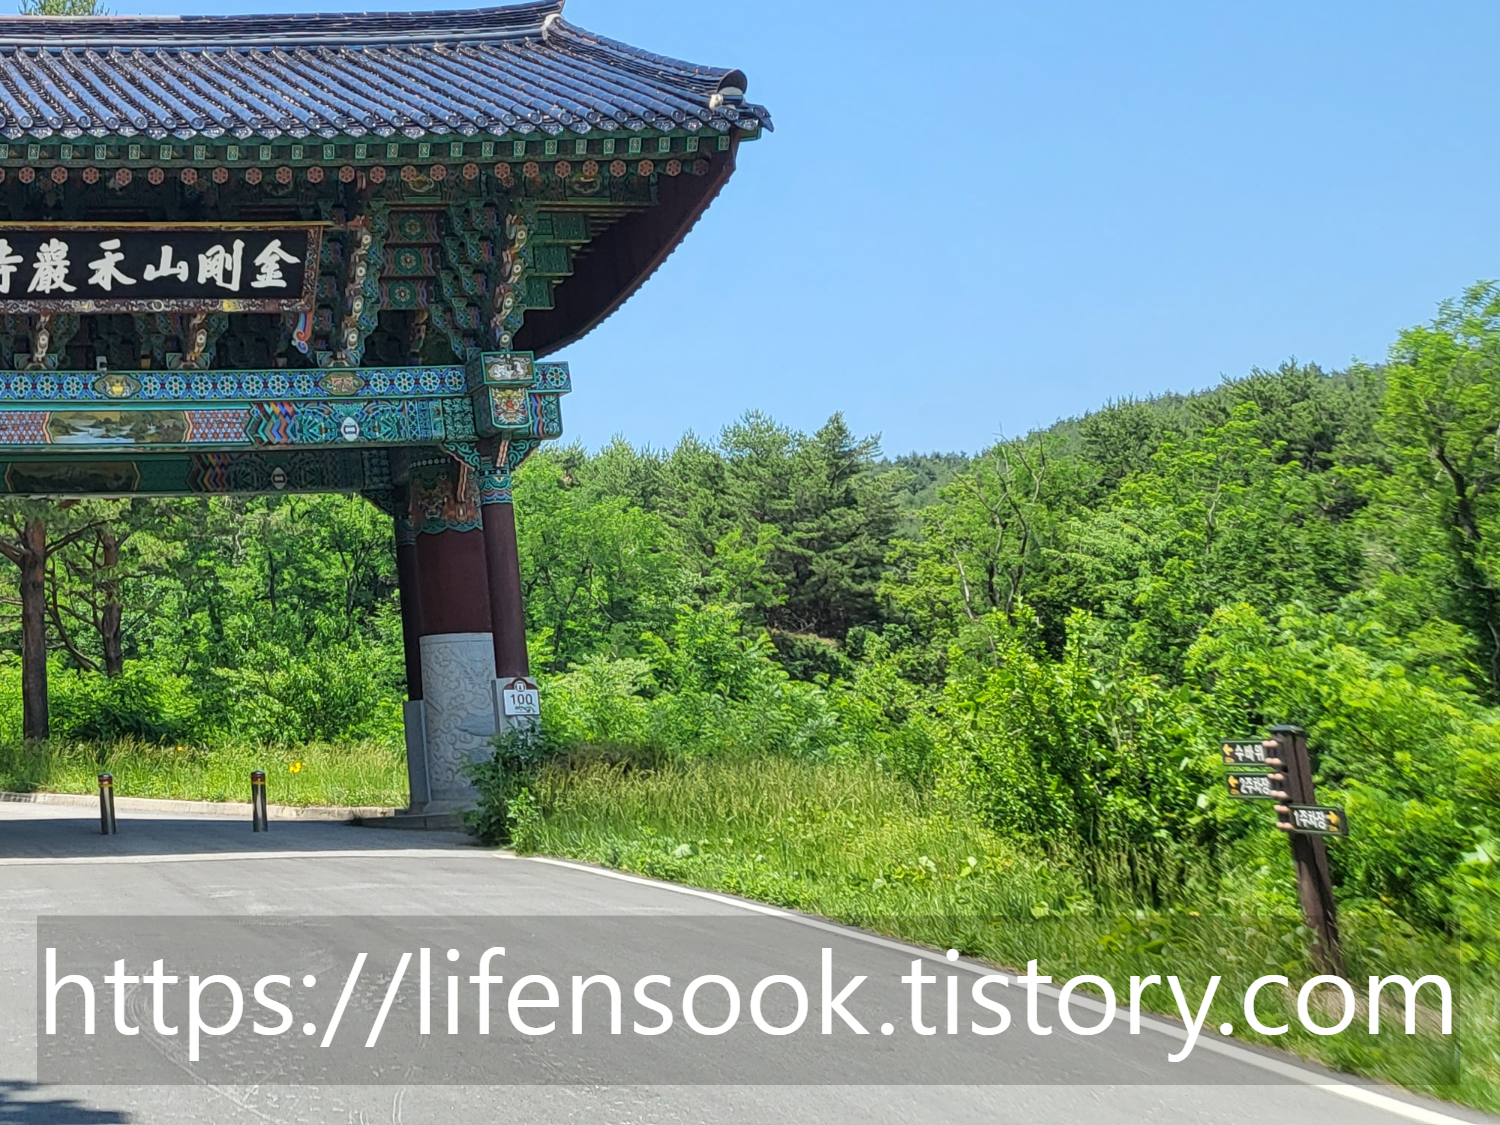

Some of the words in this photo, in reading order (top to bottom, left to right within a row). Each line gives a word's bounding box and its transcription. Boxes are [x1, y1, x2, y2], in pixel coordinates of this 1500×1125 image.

[510, 693, 533, 705] 100
[1239, 777, 1271, 795] 2주차장
[1293, 809, 1328, 830] 1주차장
